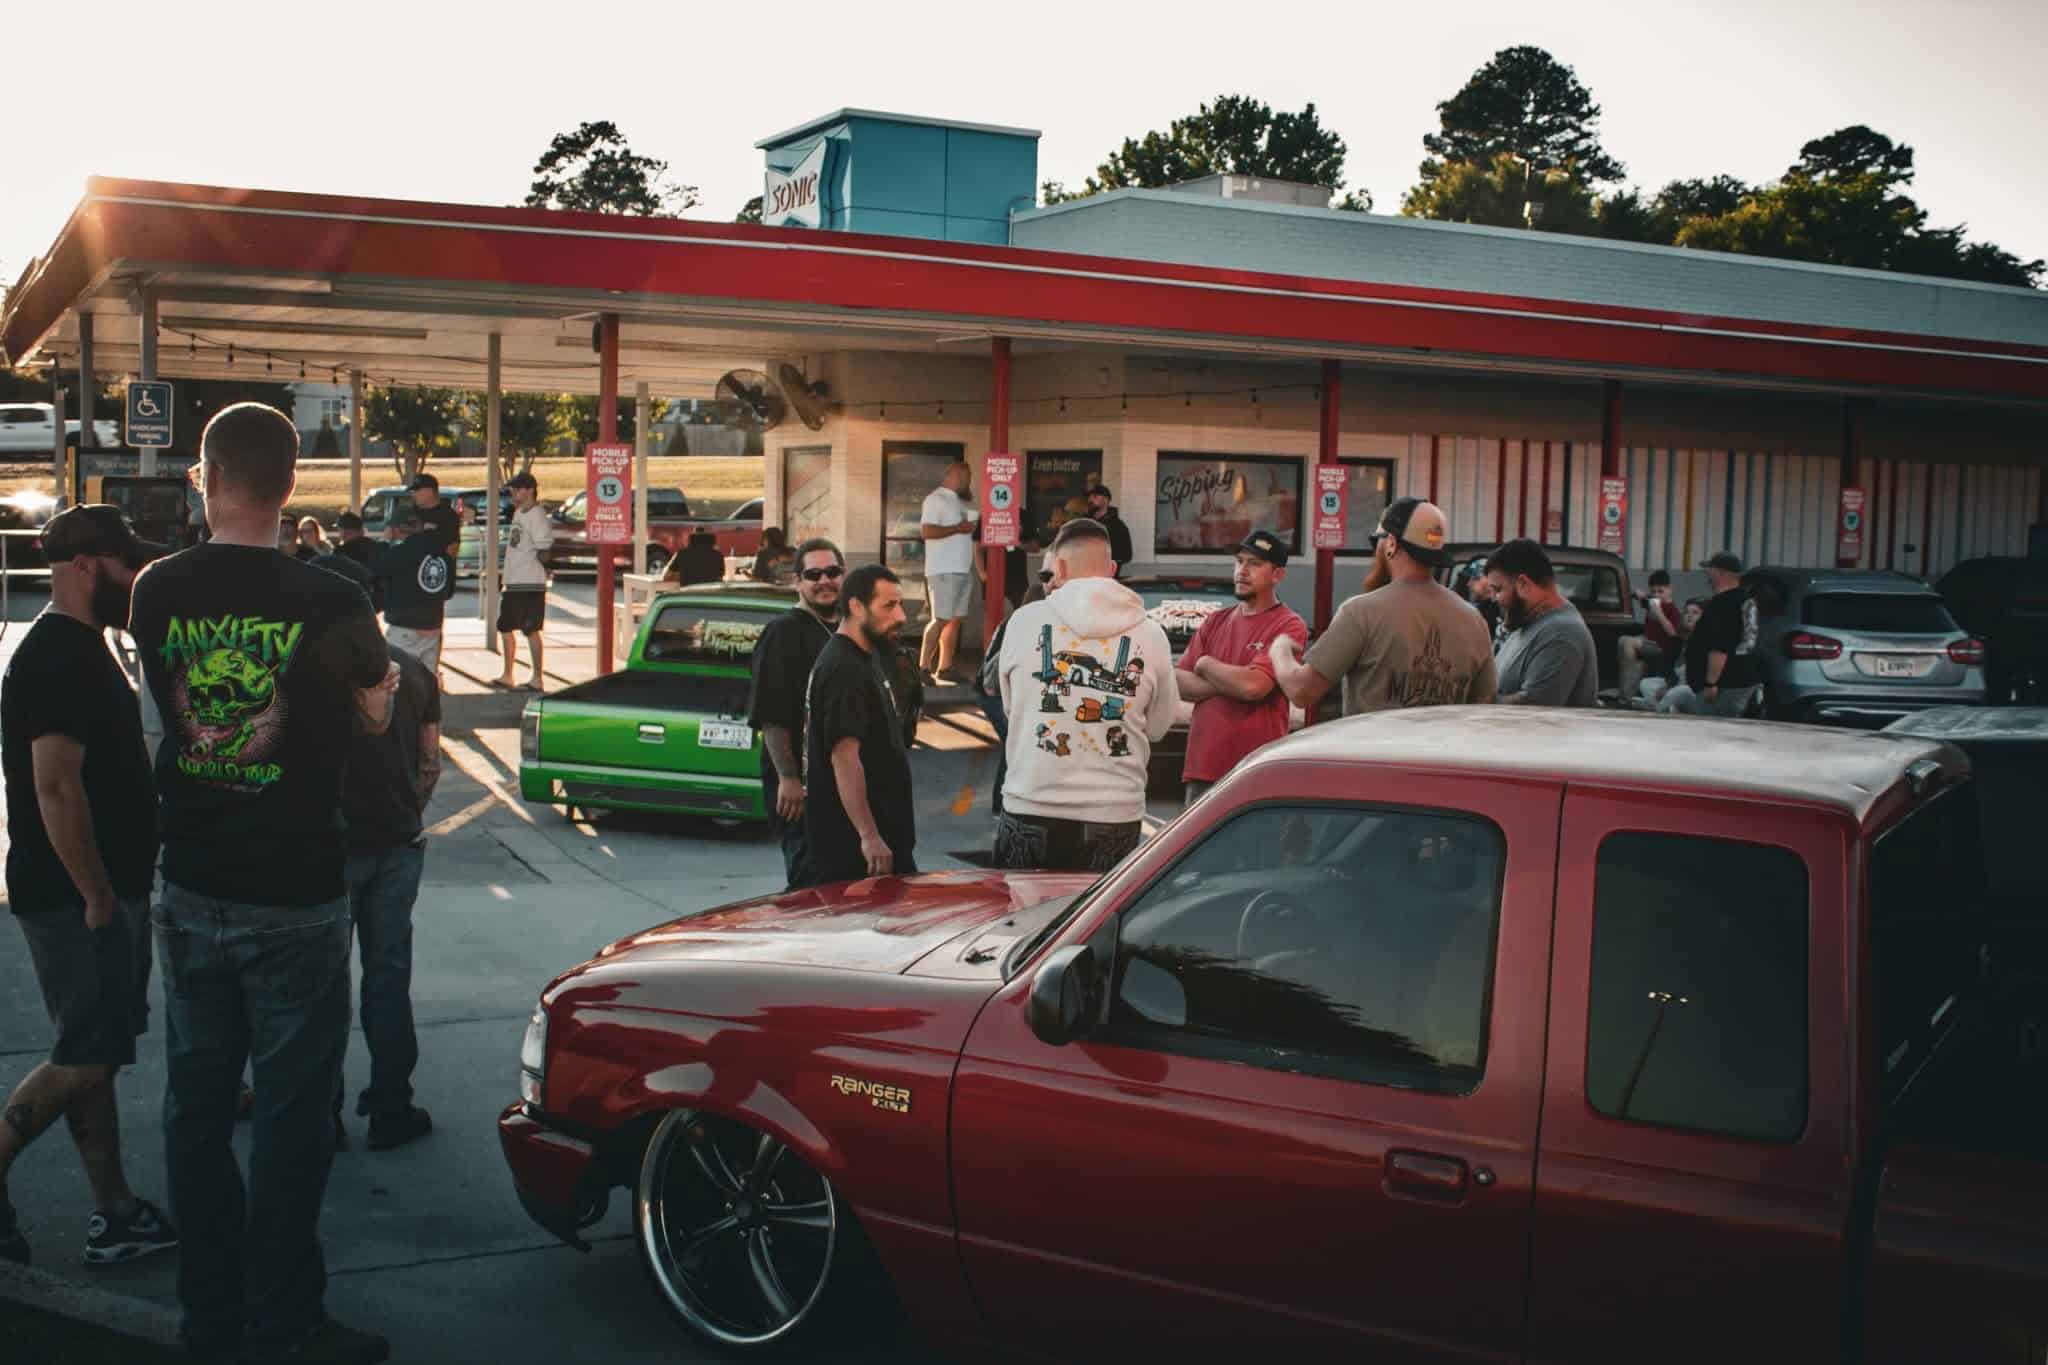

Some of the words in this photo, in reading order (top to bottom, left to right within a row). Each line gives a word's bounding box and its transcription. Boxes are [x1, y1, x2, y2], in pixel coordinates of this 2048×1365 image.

[768, 172, 818, 215] SONIC
[591, 448, 628, 457] MOBILE
[591, 457, 629, 465] PICK-UP
[987, 457, 1017, 465] MOBILE
[597, 465, 624, 474] ONLY
[987, 465, 1018, 473] PICK-UP
[991, 473, 1013, 481] ONLY
[601, 484, 617, 497] 13
[1160, 468, 1234, 508] Sipping
[995, 490, 1008, 501] 14
[1325, 496, 1337, 507] 15
[159, 613, 305, 673] ANXIETY
[831, 1074, 910, 1103] RANGER
